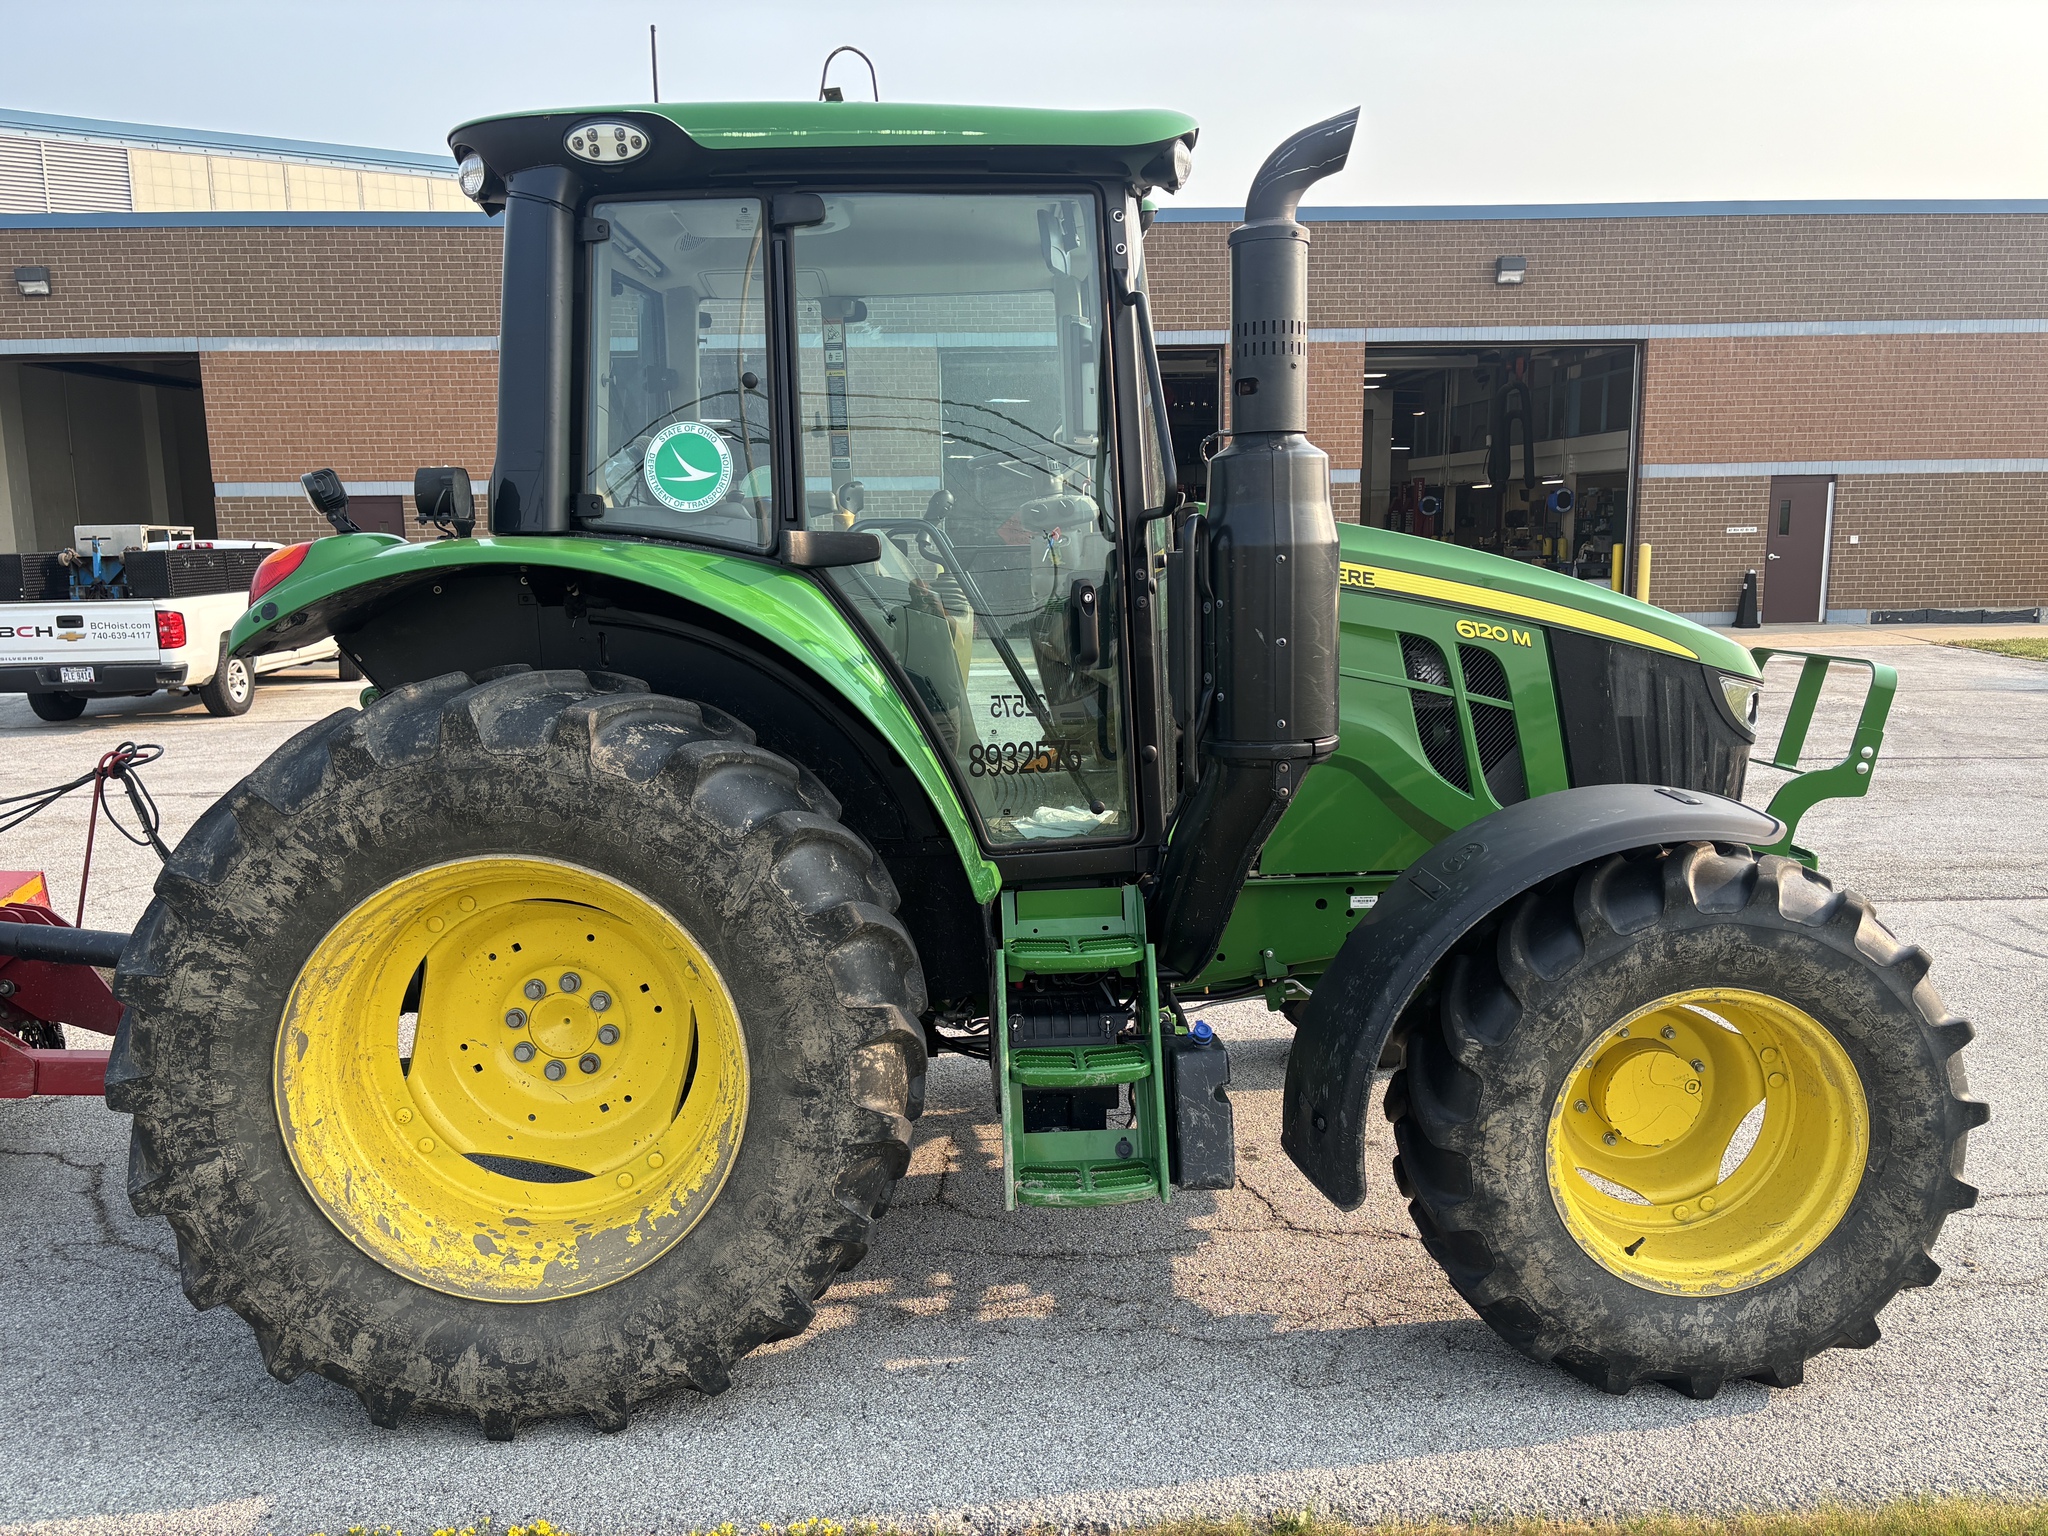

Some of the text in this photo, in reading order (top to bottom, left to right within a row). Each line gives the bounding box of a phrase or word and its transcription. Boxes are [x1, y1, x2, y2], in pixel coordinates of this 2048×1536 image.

[658, 424, 718, 444] STATE OF OHIO
[647, 452, 730, 509] DEPARTMENT OF TRANSPORTATION
[0, 626, 54, 638] BCH
[89, 621, 151, 630] BCHoist.com
[91, 631, 151, 640] 740-639-4117
[1455, 619, 1532, 648] 6120 M
[969, 740, 1082, 777] 8932575
